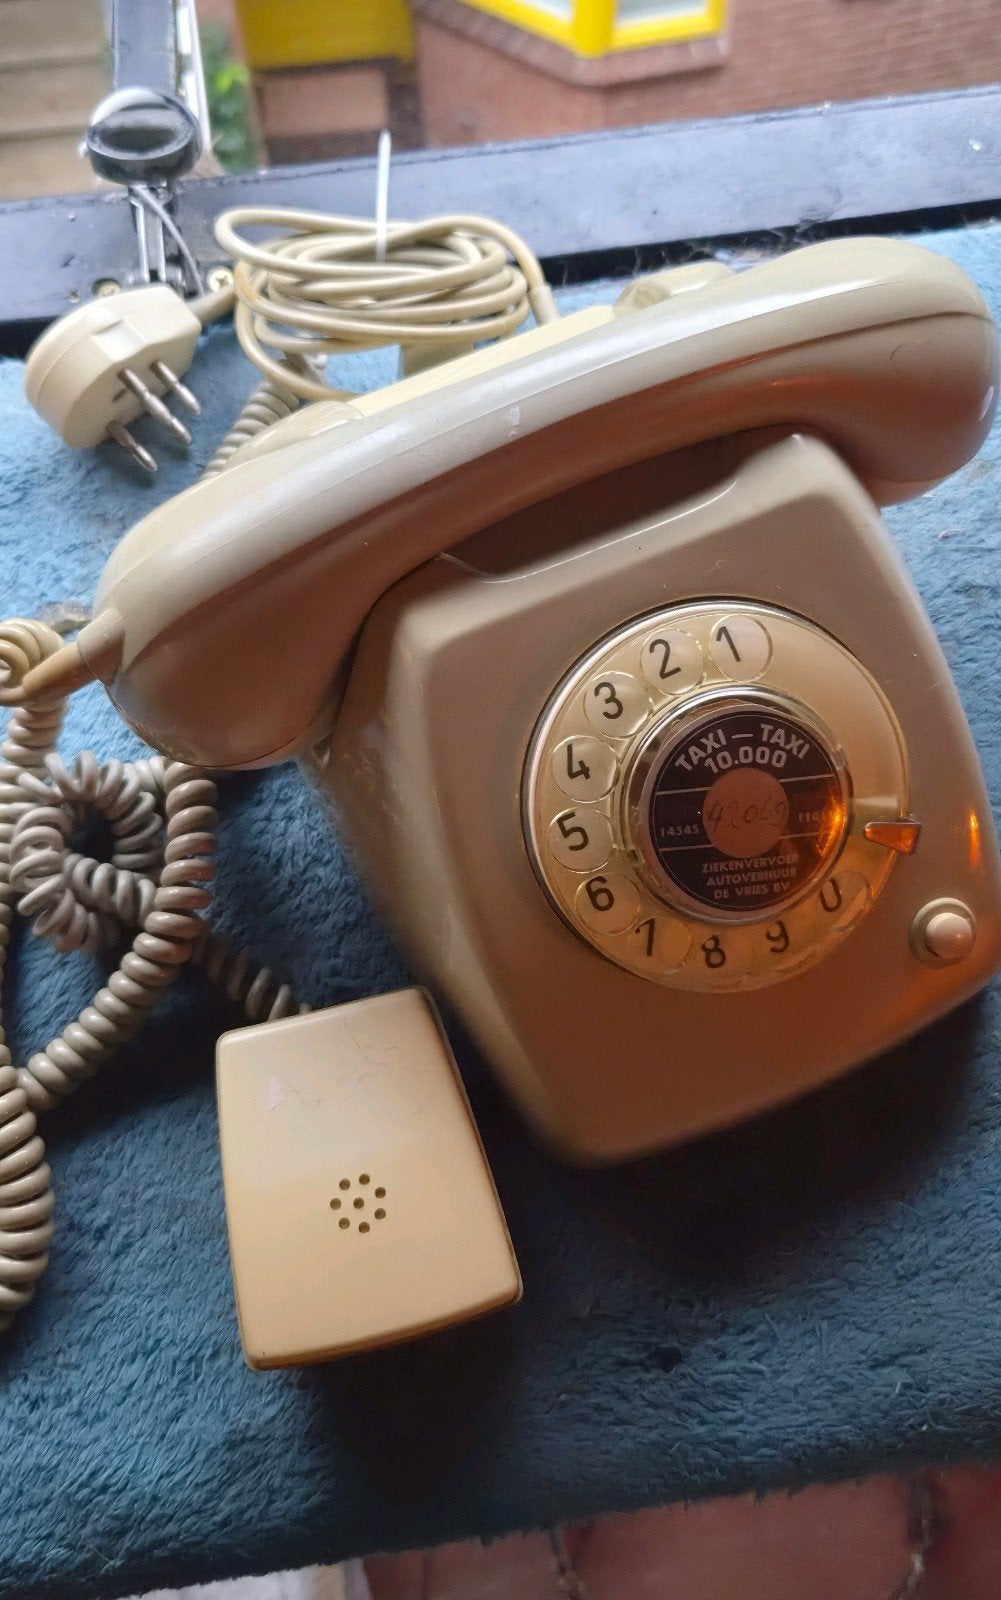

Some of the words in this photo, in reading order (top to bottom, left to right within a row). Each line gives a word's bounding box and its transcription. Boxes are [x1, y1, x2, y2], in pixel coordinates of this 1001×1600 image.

[649, 638, 681, 680] 2
[716, 625, 741, 663] 1
[594, 681, 624, 720] 3
[566, 743, 591, 781] 4
[674, 728, 728, 772] TAXI
[760, 723, 811, 760] TAXI
[704, 746, 788, 774] 10.000
[556, 811, 589, 852] 5
[585, 875, 615, 912] 6
[713, 888, 730, 901] DE
[734, 884, 769, 898] VRIES
[635, 917, 657, 957] 7
[701, 934, 726, 969] 8
[765, 920, 790, 954] 9
